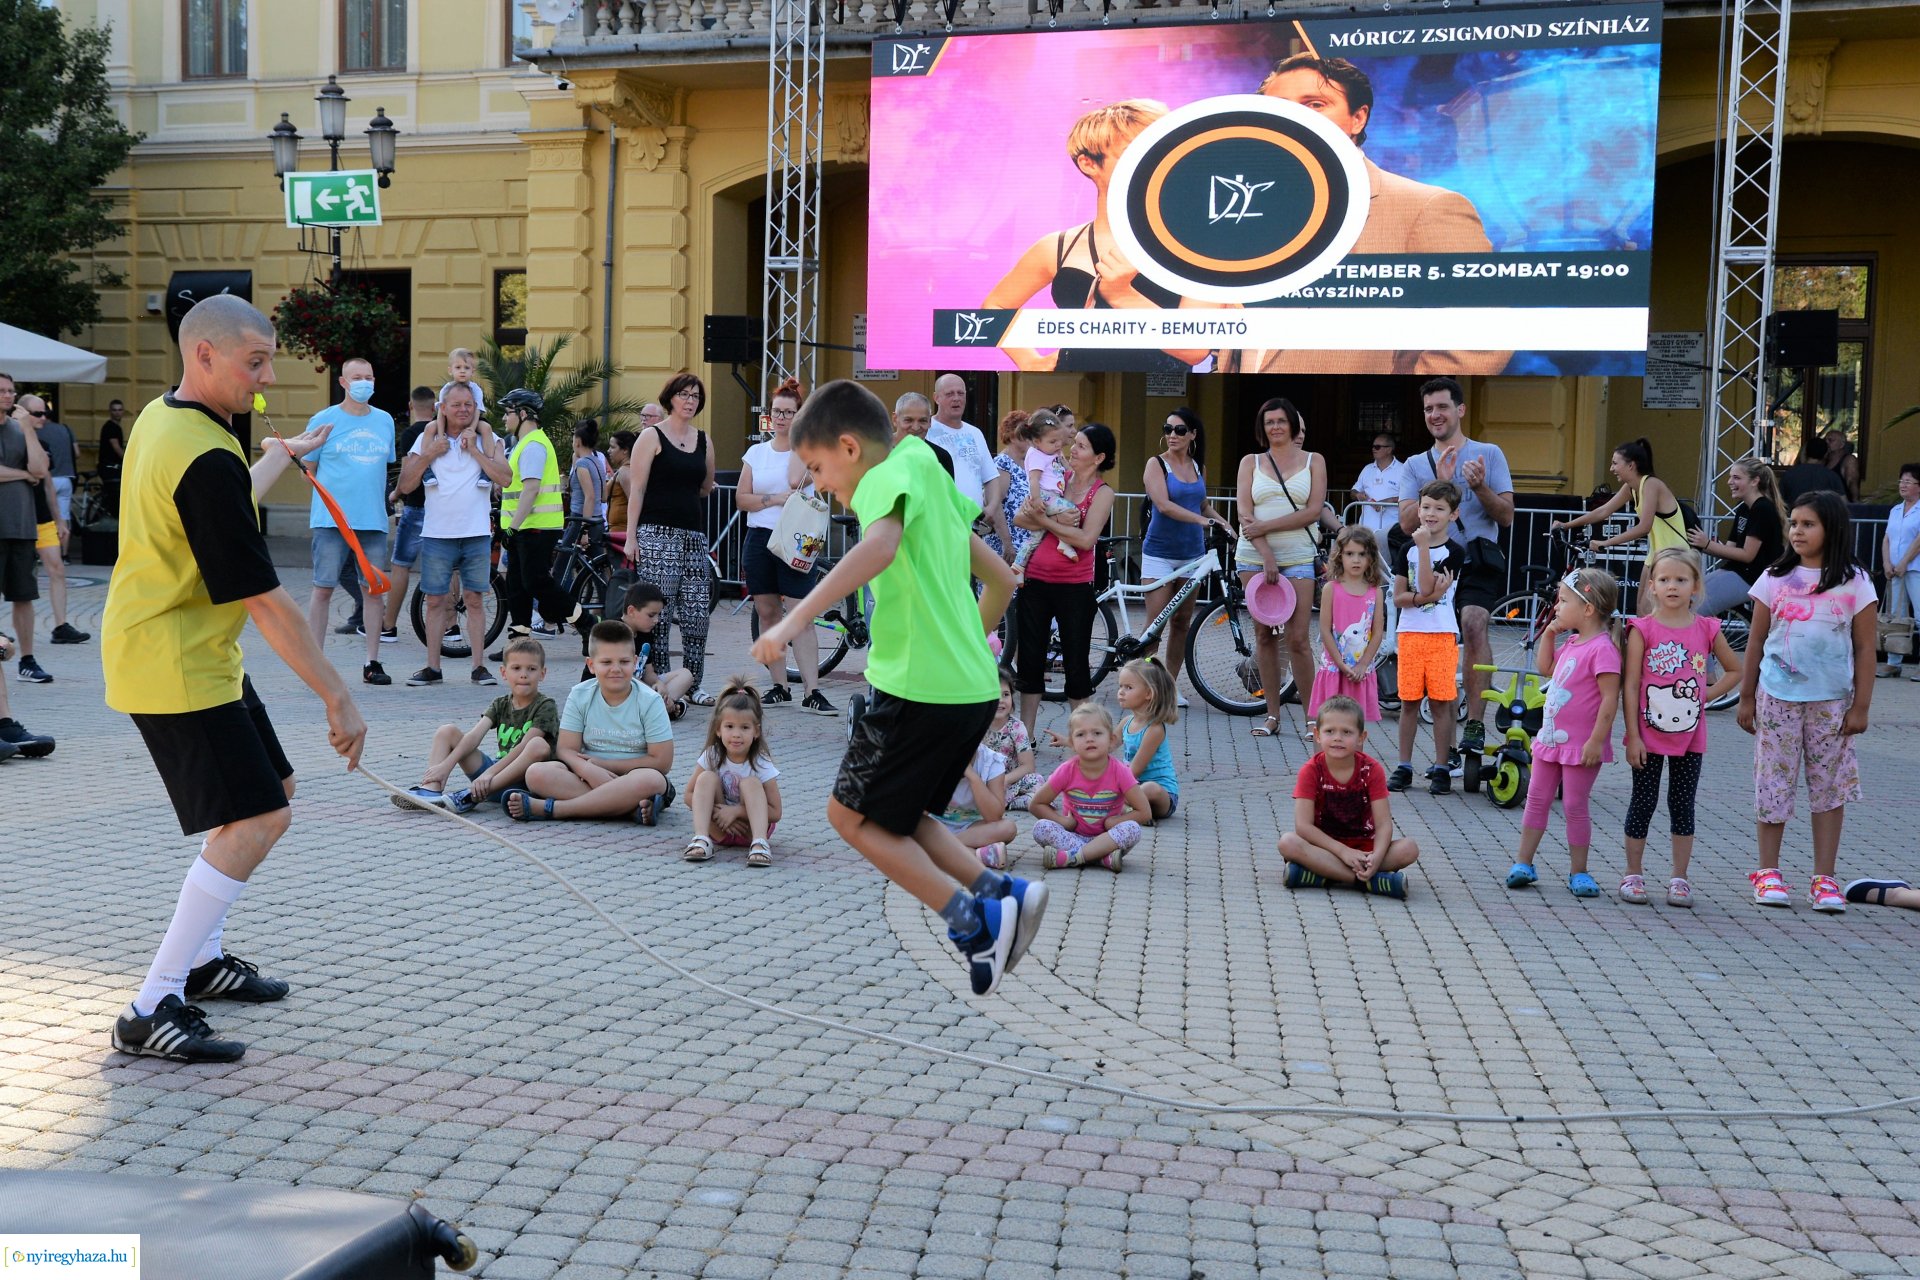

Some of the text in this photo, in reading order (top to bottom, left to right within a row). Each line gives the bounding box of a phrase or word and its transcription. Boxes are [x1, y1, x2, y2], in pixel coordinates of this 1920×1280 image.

[1329, 16, 1650, 47] MÓRICZ ZSIGMOND SZÍNHÁZ
[1427, 265, 1446, 280] 5.
[1452, 262, 1561, 278] SZOMBAT
[1566, 263, 1630, 279] 19:00
[1037, 318, 1075, 335] ÉDES
[1080, 321, 1147, 335] CHARITY
[1162, 318, 1248, 335] BEMUTATÓ
[1153, 579, 1195, 627] KILIMANJARO
[1651, 645, 1678, 661] HELLO
[1656, 655, 1680, 672] KITTY
